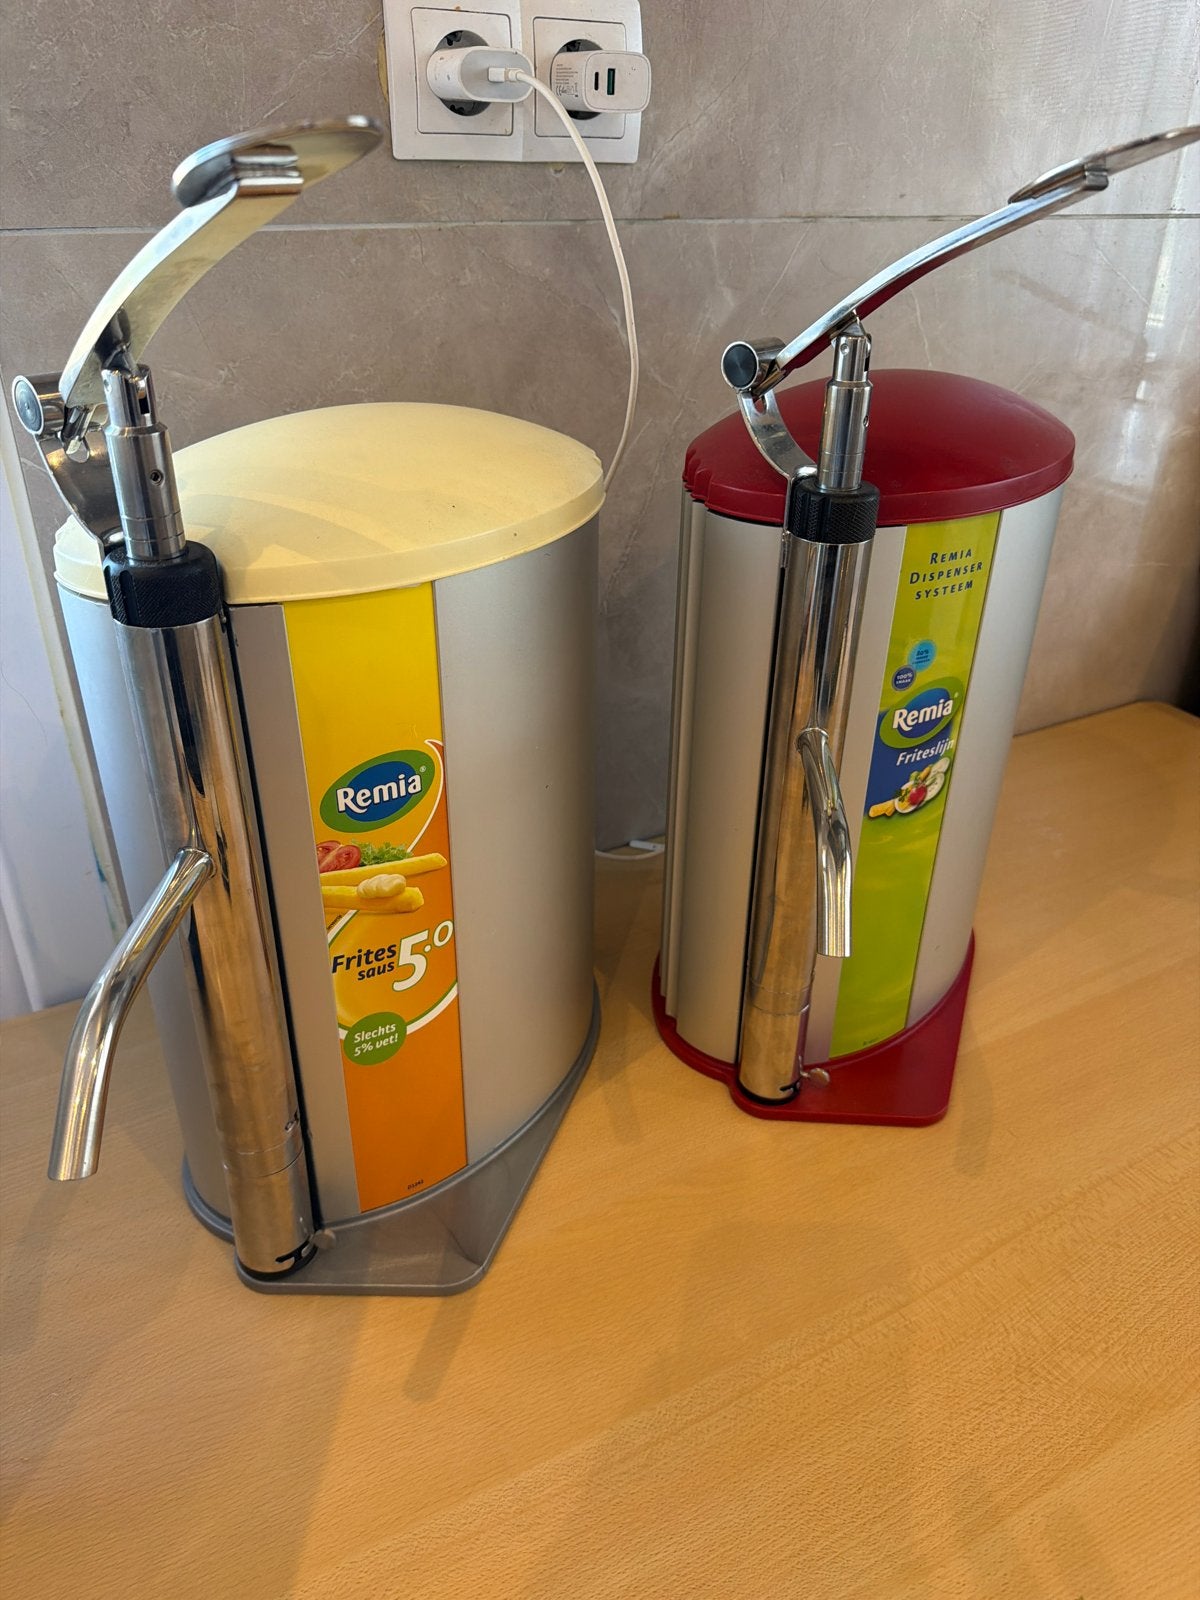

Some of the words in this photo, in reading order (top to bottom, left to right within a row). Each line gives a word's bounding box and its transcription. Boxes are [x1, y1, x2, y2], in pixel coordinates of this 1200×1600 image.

[897, 672, 913, 680] 100%
[892, 698, 954, 732] Remia
[895, 738, 955, 766] Friteslijn
[336, 773, 422, 814] Remia
[331, 944, 397, 973] Frites
[357, 961, 395, 981] saus
[353, 1023, 396, 1043] Slechts
[354, 1043, 374, 1057] 5%
[375, 1033, 398, 1048] vet!
